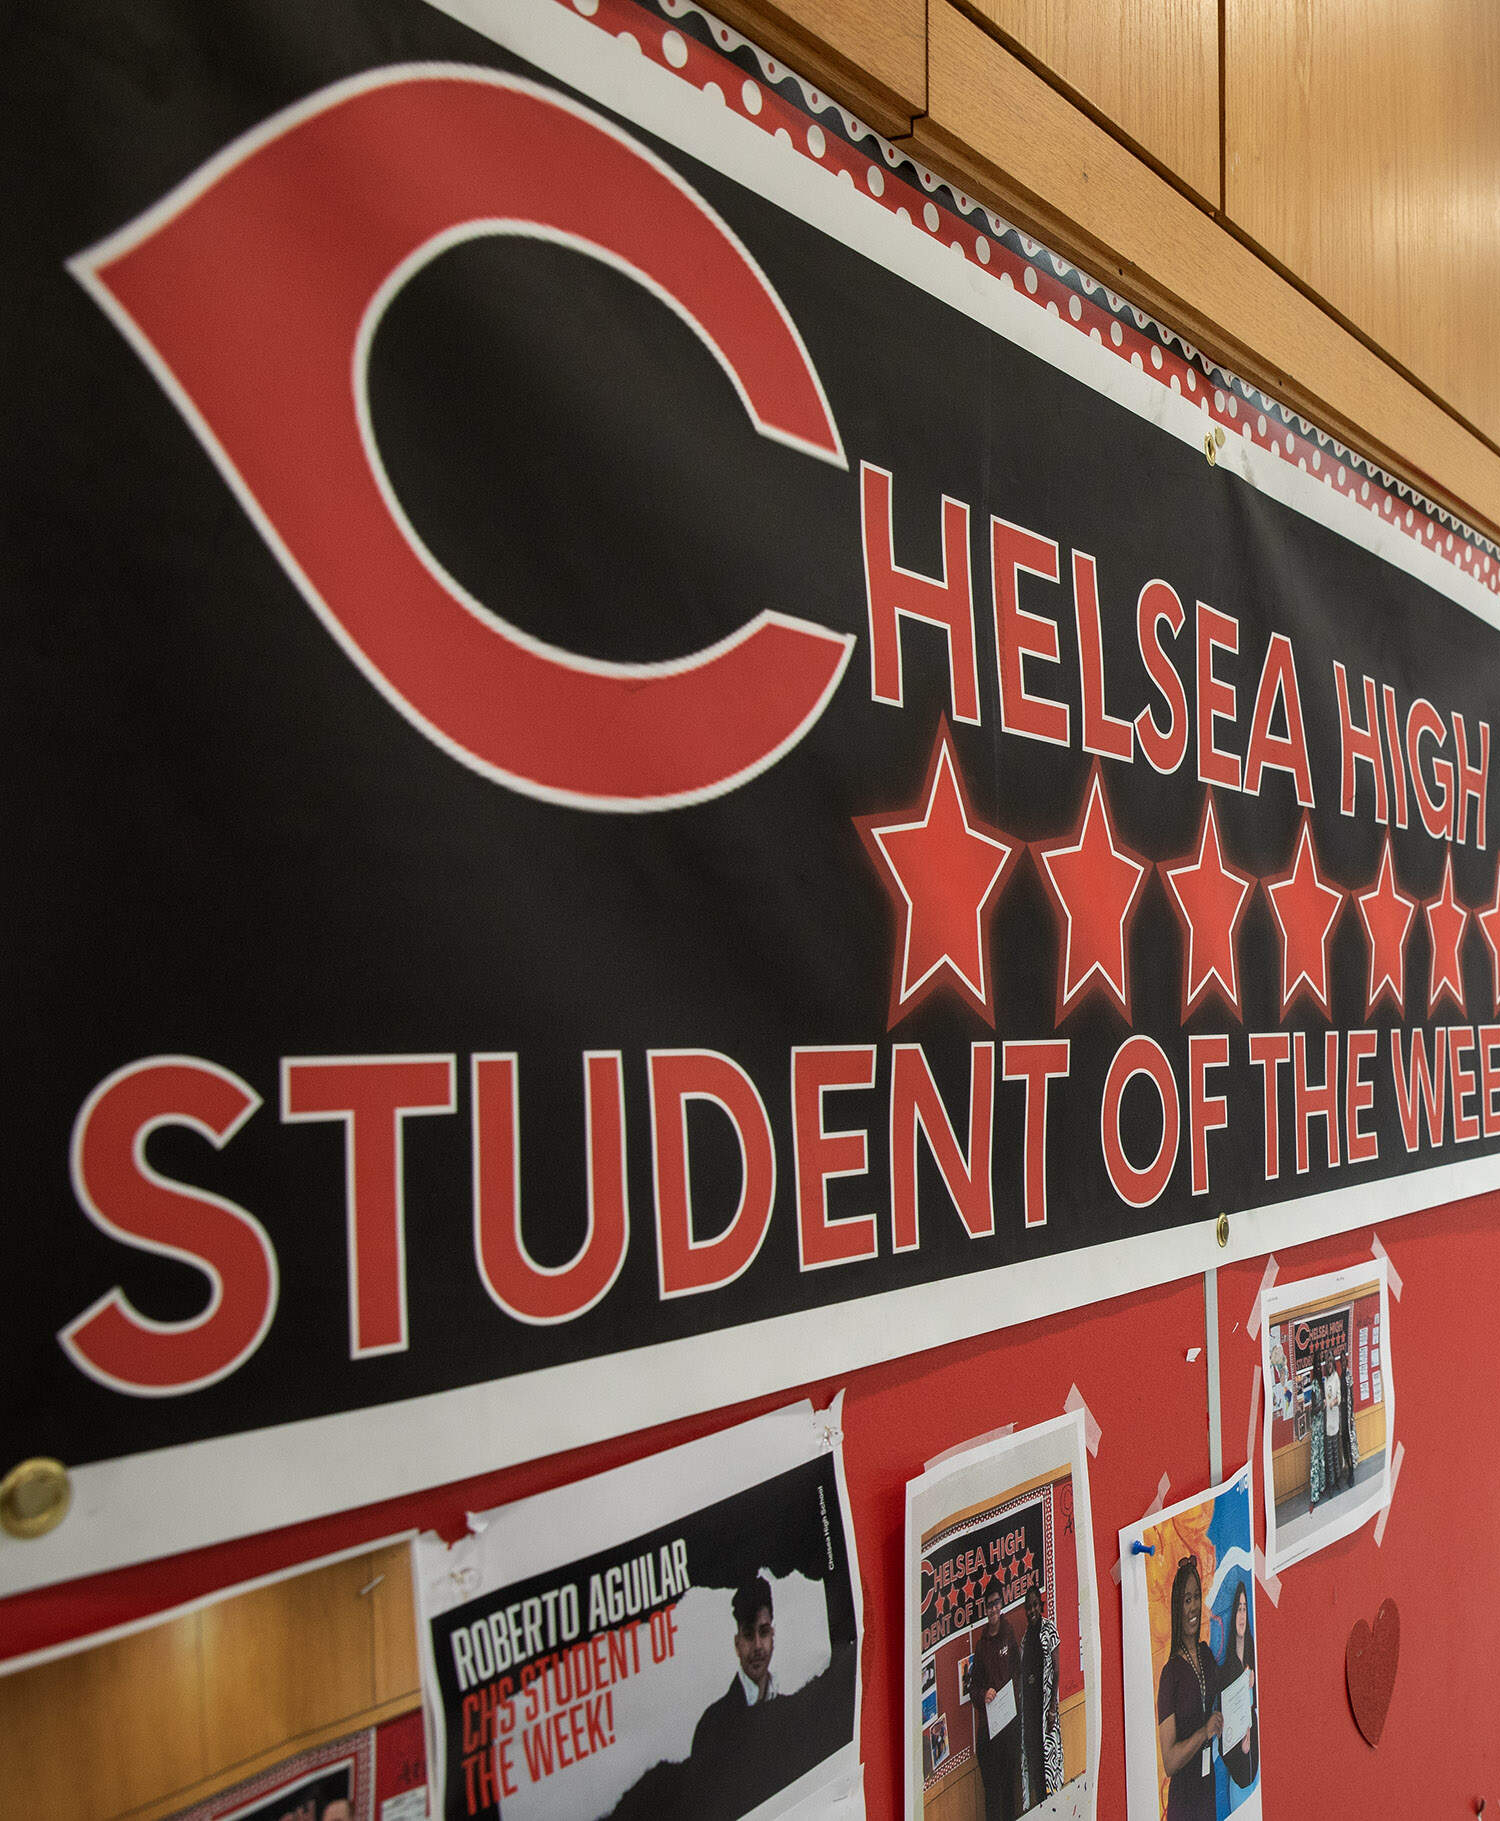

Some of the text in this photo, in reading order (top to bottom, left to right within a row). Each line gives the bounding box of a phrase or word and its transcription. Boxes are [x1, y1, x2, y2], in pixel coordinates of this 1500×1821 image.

[64, 61, 1491, 851] CHELSEA HIGH
[57, 1040, 1071, 1399] STUDENT
[1100, 1033, 1230, 1208] OF
[1248, 1028, 1379, 1182] THE
[449, 1537, 692, 1693] ROBERTO AGUILAR
[989, 1526, 1026, 1565] HIGH
[461, 1603, 679, 1756] CHS STUDENT OF
[461, 1690, 617, 1817] THE WEEK!
